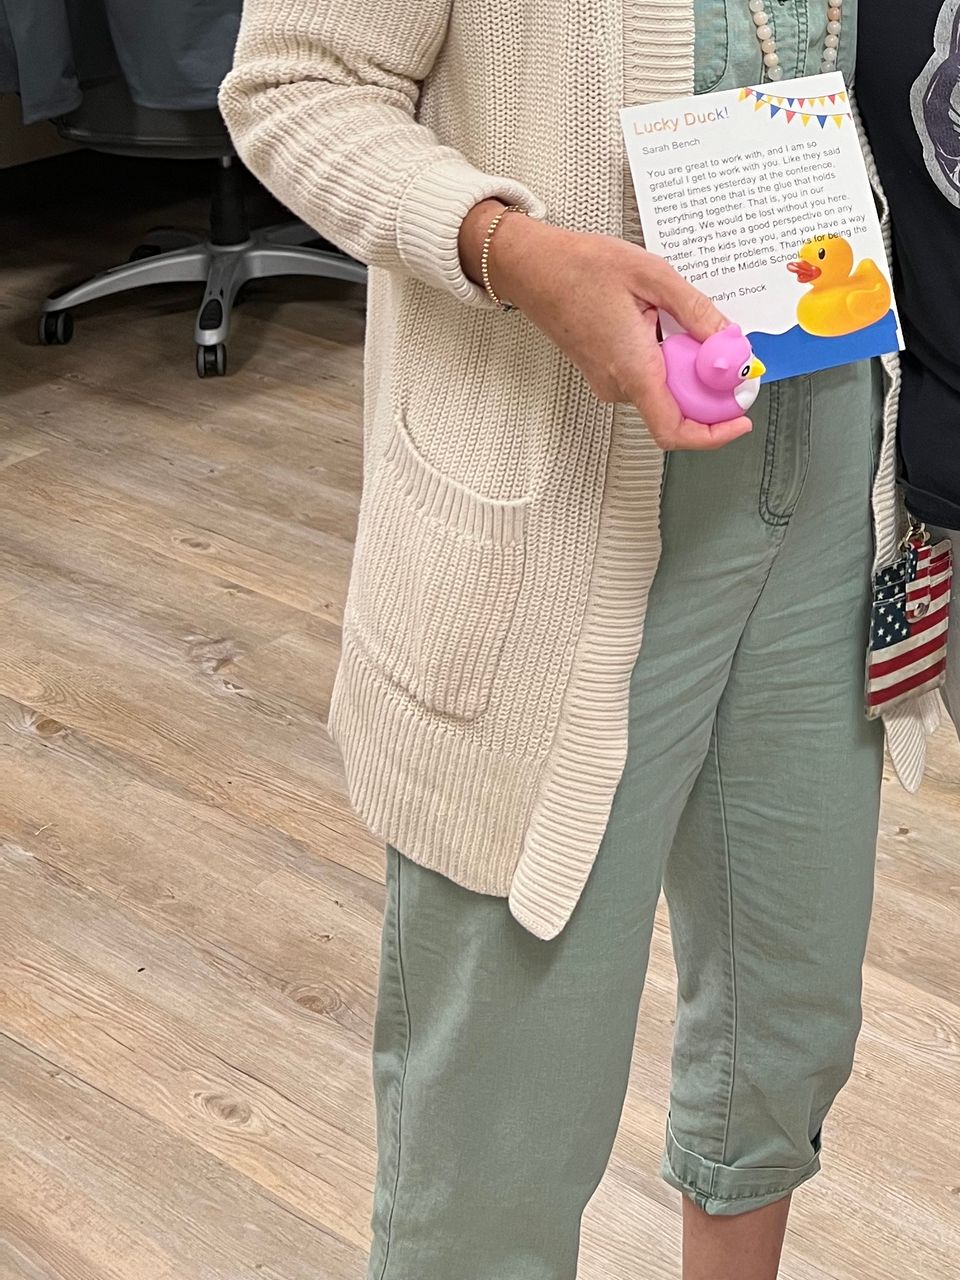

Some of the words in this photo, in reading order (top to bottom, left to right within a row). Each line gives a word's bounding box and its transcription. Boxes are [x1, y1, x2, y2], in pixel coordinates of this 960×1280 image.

[633, 118, 679, 135] Lucky
[684, 106, 729, 126] Duck!
[642, 144, 670, 155] Sarah
[672, 138, 700, 149] Bench
[646, 170, 666, 178] You
[685, 160, 709, 173] great
[721, 154, 742, 164] work
[745, 150, 764, 159] with,
[767, 146, 783, 155] and
[649, 176, 684, 192] grateful
[691, 173, 706, 184] get
[719, 166, 740, 176] work
[742, 163, 760, 171] with
[783, 156, 800, 164] Like
[803, 152, 820, 160] they
[823, 147, 840, 156] said
[652, 189, 685, 202] several
[687, 185, 712, 195] times
[713, 177, 756, 192] yesterday
[759, 173, 767, 181] at
[769, 171, 783, 179] the
[654, 204, 678, 214] there
[690, 197, 708, 207] that
[710, 194, 726, 203] one
[728, 189, 746, 199] that
[757, 185, 771, 193] the
[773, 181, 792, 192] glue
[794, 177, 811, 186] that
[813, 172, 836, 182] holds
[657, 211, 704, 226] everything
[747, 197, 767, 206] That
[782, 192, 798, 202] you
[810, 186, 824, 194] our
[659, 226, 697, 238] building.
[698, 221, 715, 229] We
[717, 214, 743, 225] would
[759, 208, 775, 217] lost
[777, 201, 808, 213] without
[810, 199, 826, 209] you
[661, 241, 680, 249] You
[682, 234, 713, 245] always
[715, 229, 737, 238] have
[748, 221, 770, 233] good
[772, 211, 822, 228] perspective
[837, 205, 852, 213] any
[677, 260, 709, 272] solving
[711, 255, 730, 264] their
[733, 246, 776, 260] problems.
[780, 237, 812, 249] Thanks
[813, 233, 826, 242] for
[827, 228, 851, 239] being
[853, 226, 867, 234] the
[698, 246, 716, 255] The
[718, 242, 736, 250] kids
[738, 238, 757, 246] love
[759, 233, 778, 244] you,
[781, 227, 797, 237] and
[799, 225, 815, 235] you
[817, 220, 838, 229] have
[690, 271, 708, 282] part
[710, 268, 719, 277] of
[721, 266, 735, 275] the
[738, 259, 767, 270] Middle
[739, 285, 767, 296] Shock
